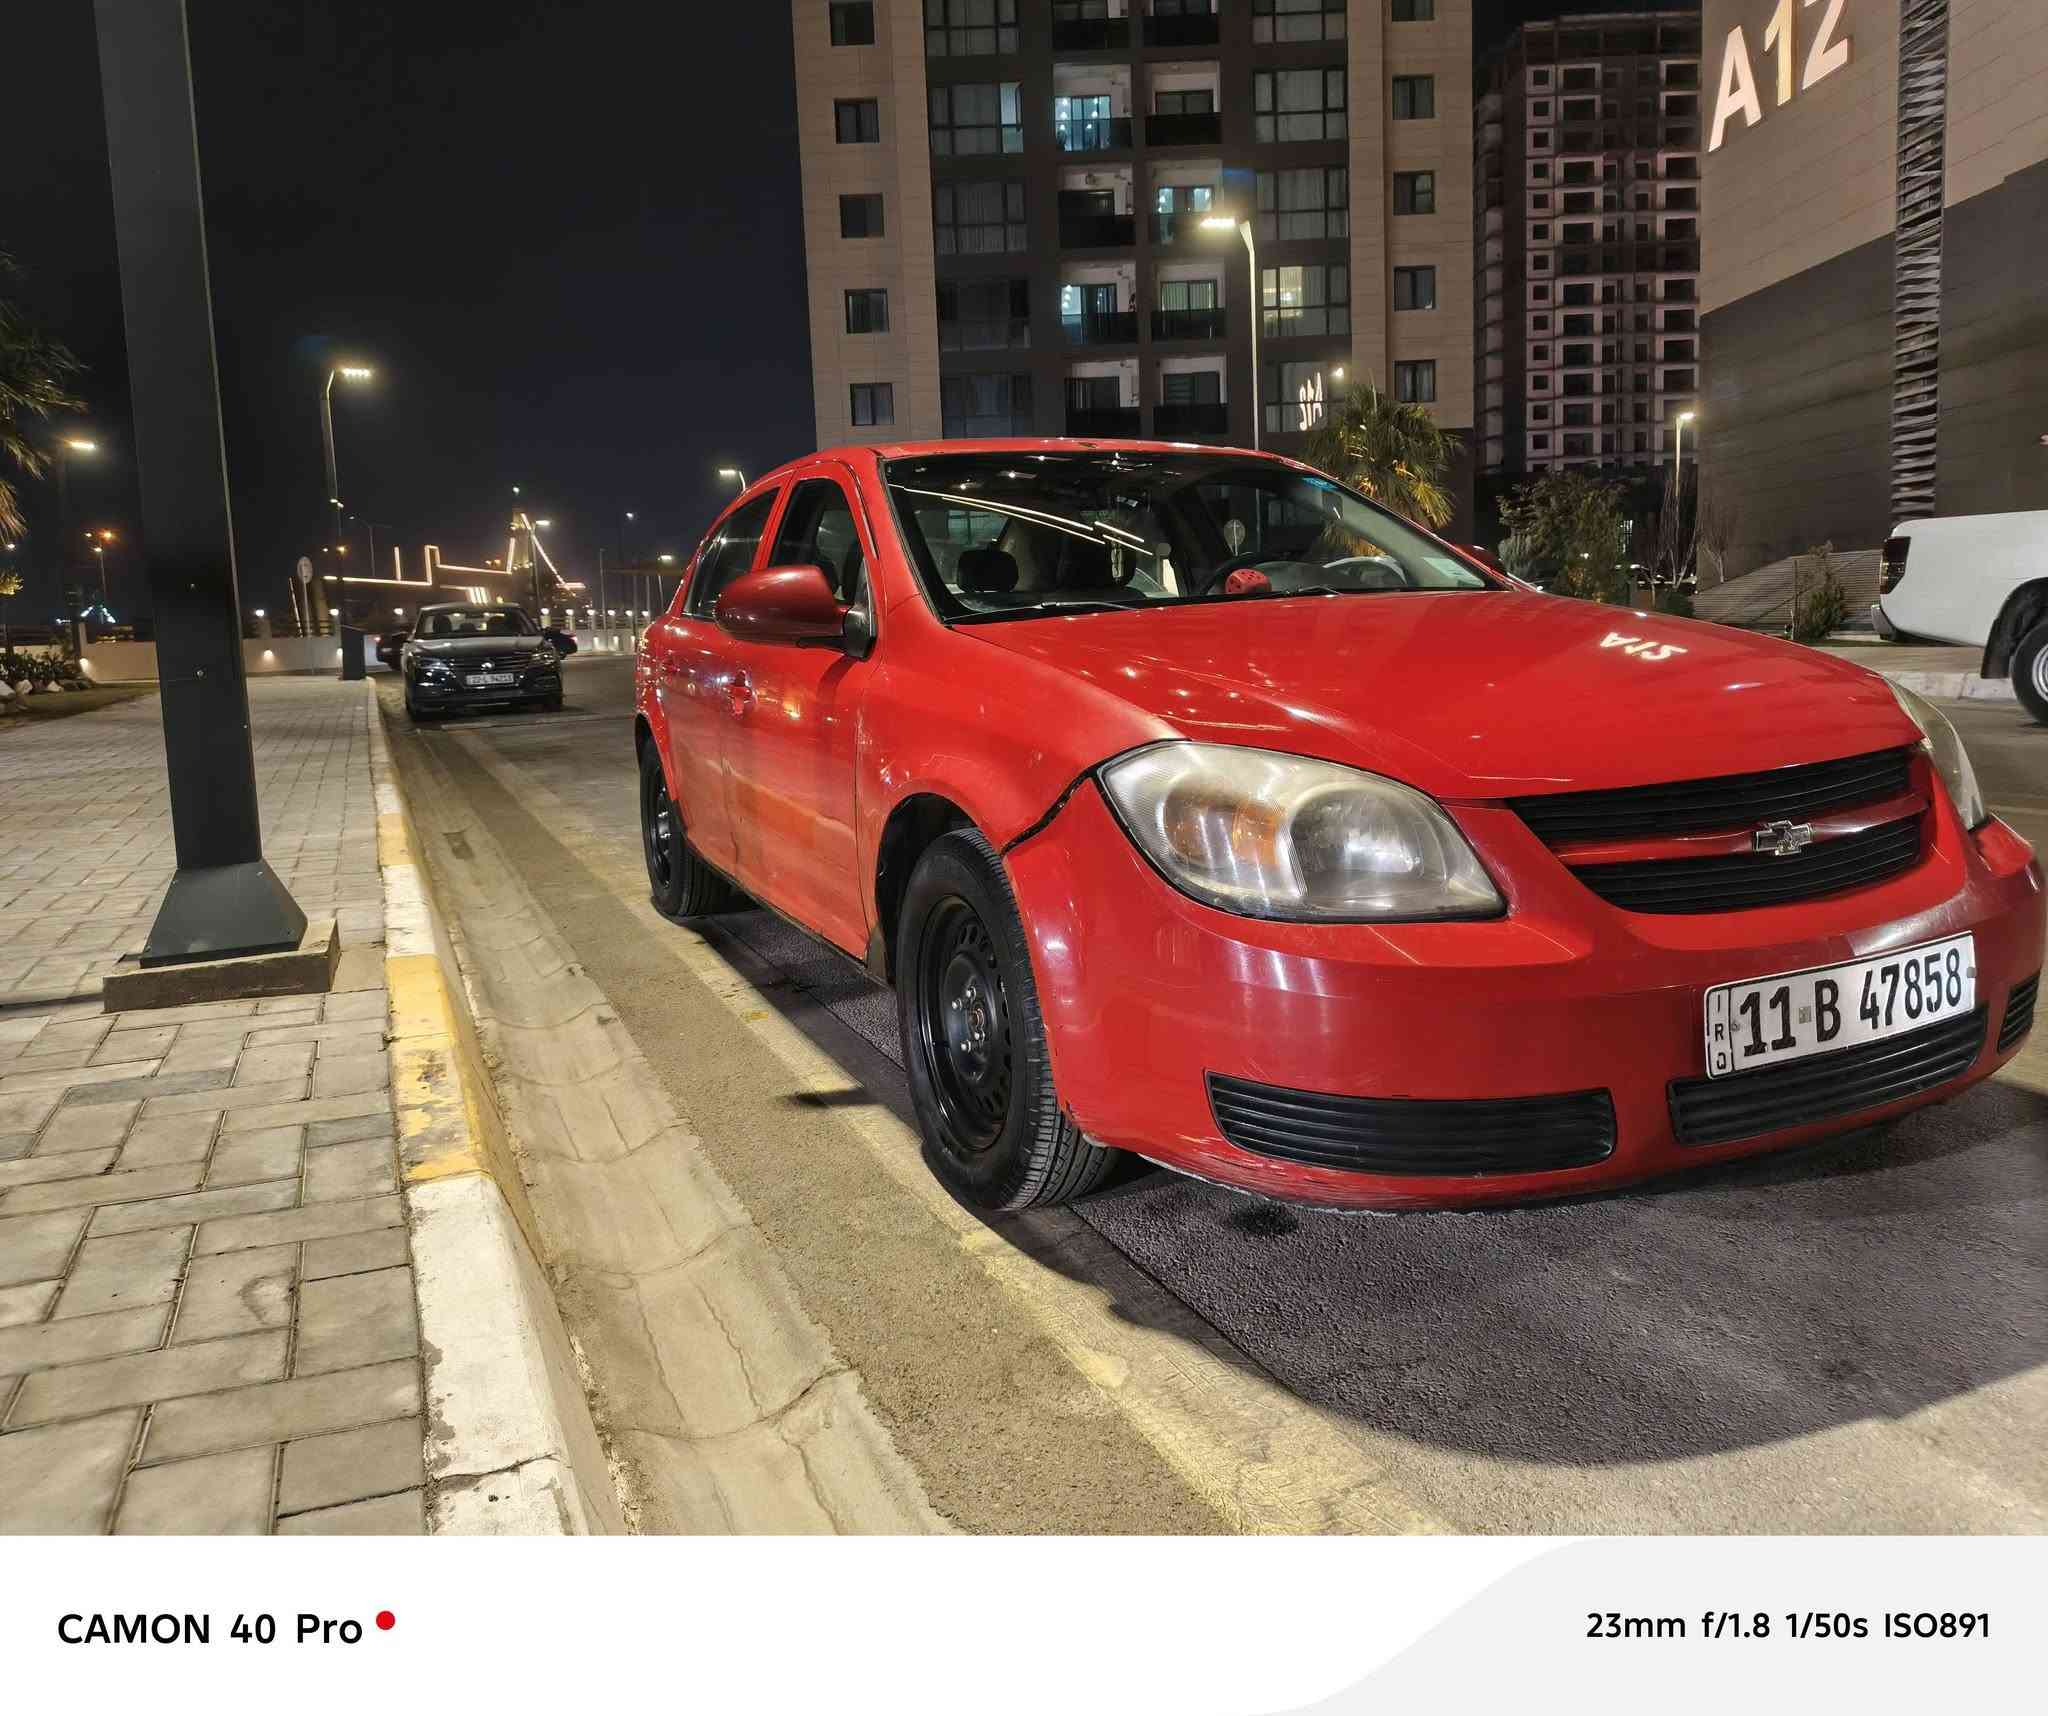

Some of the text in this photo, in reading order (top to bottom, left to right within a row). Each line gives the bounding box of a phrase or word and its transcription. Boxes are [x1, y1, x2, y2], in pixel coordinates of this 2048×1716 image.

[1709, 0, 1848, 152] A12
[1739, 948, 1962, 1057] 11 B 47858
